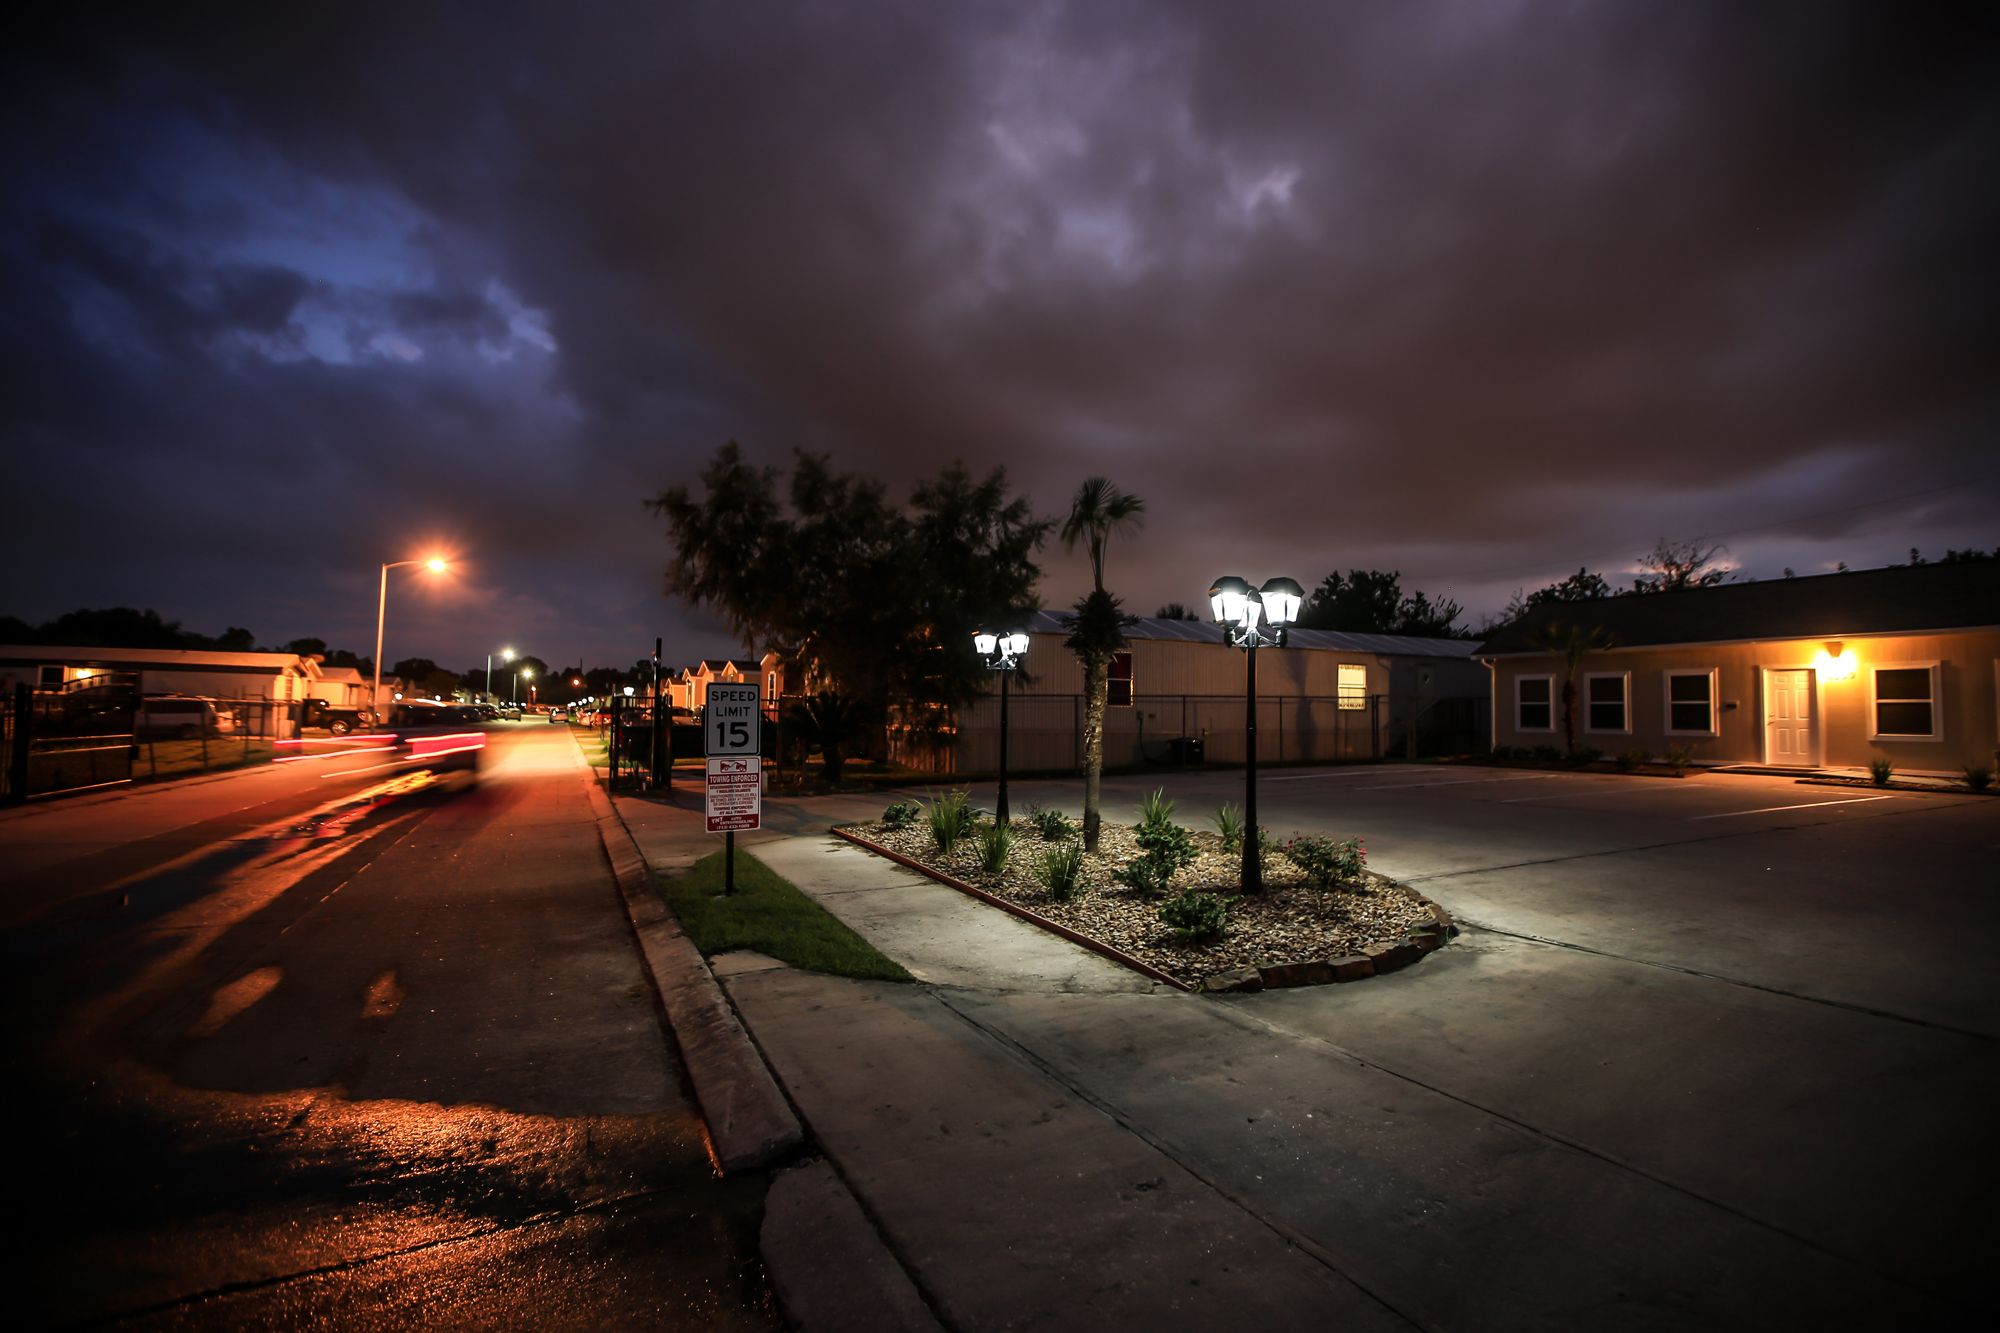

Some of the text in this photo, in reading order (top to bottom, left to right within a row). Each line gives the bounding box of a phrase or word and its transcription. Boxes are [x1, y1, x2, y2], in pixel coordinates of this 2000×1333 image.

[712, 691, 756, 701] SPEED
[716, 706, 750, 717] LIMIT
[717, 722, 749, 748] 15
[731, 774, 758, 782] ENFORCED
